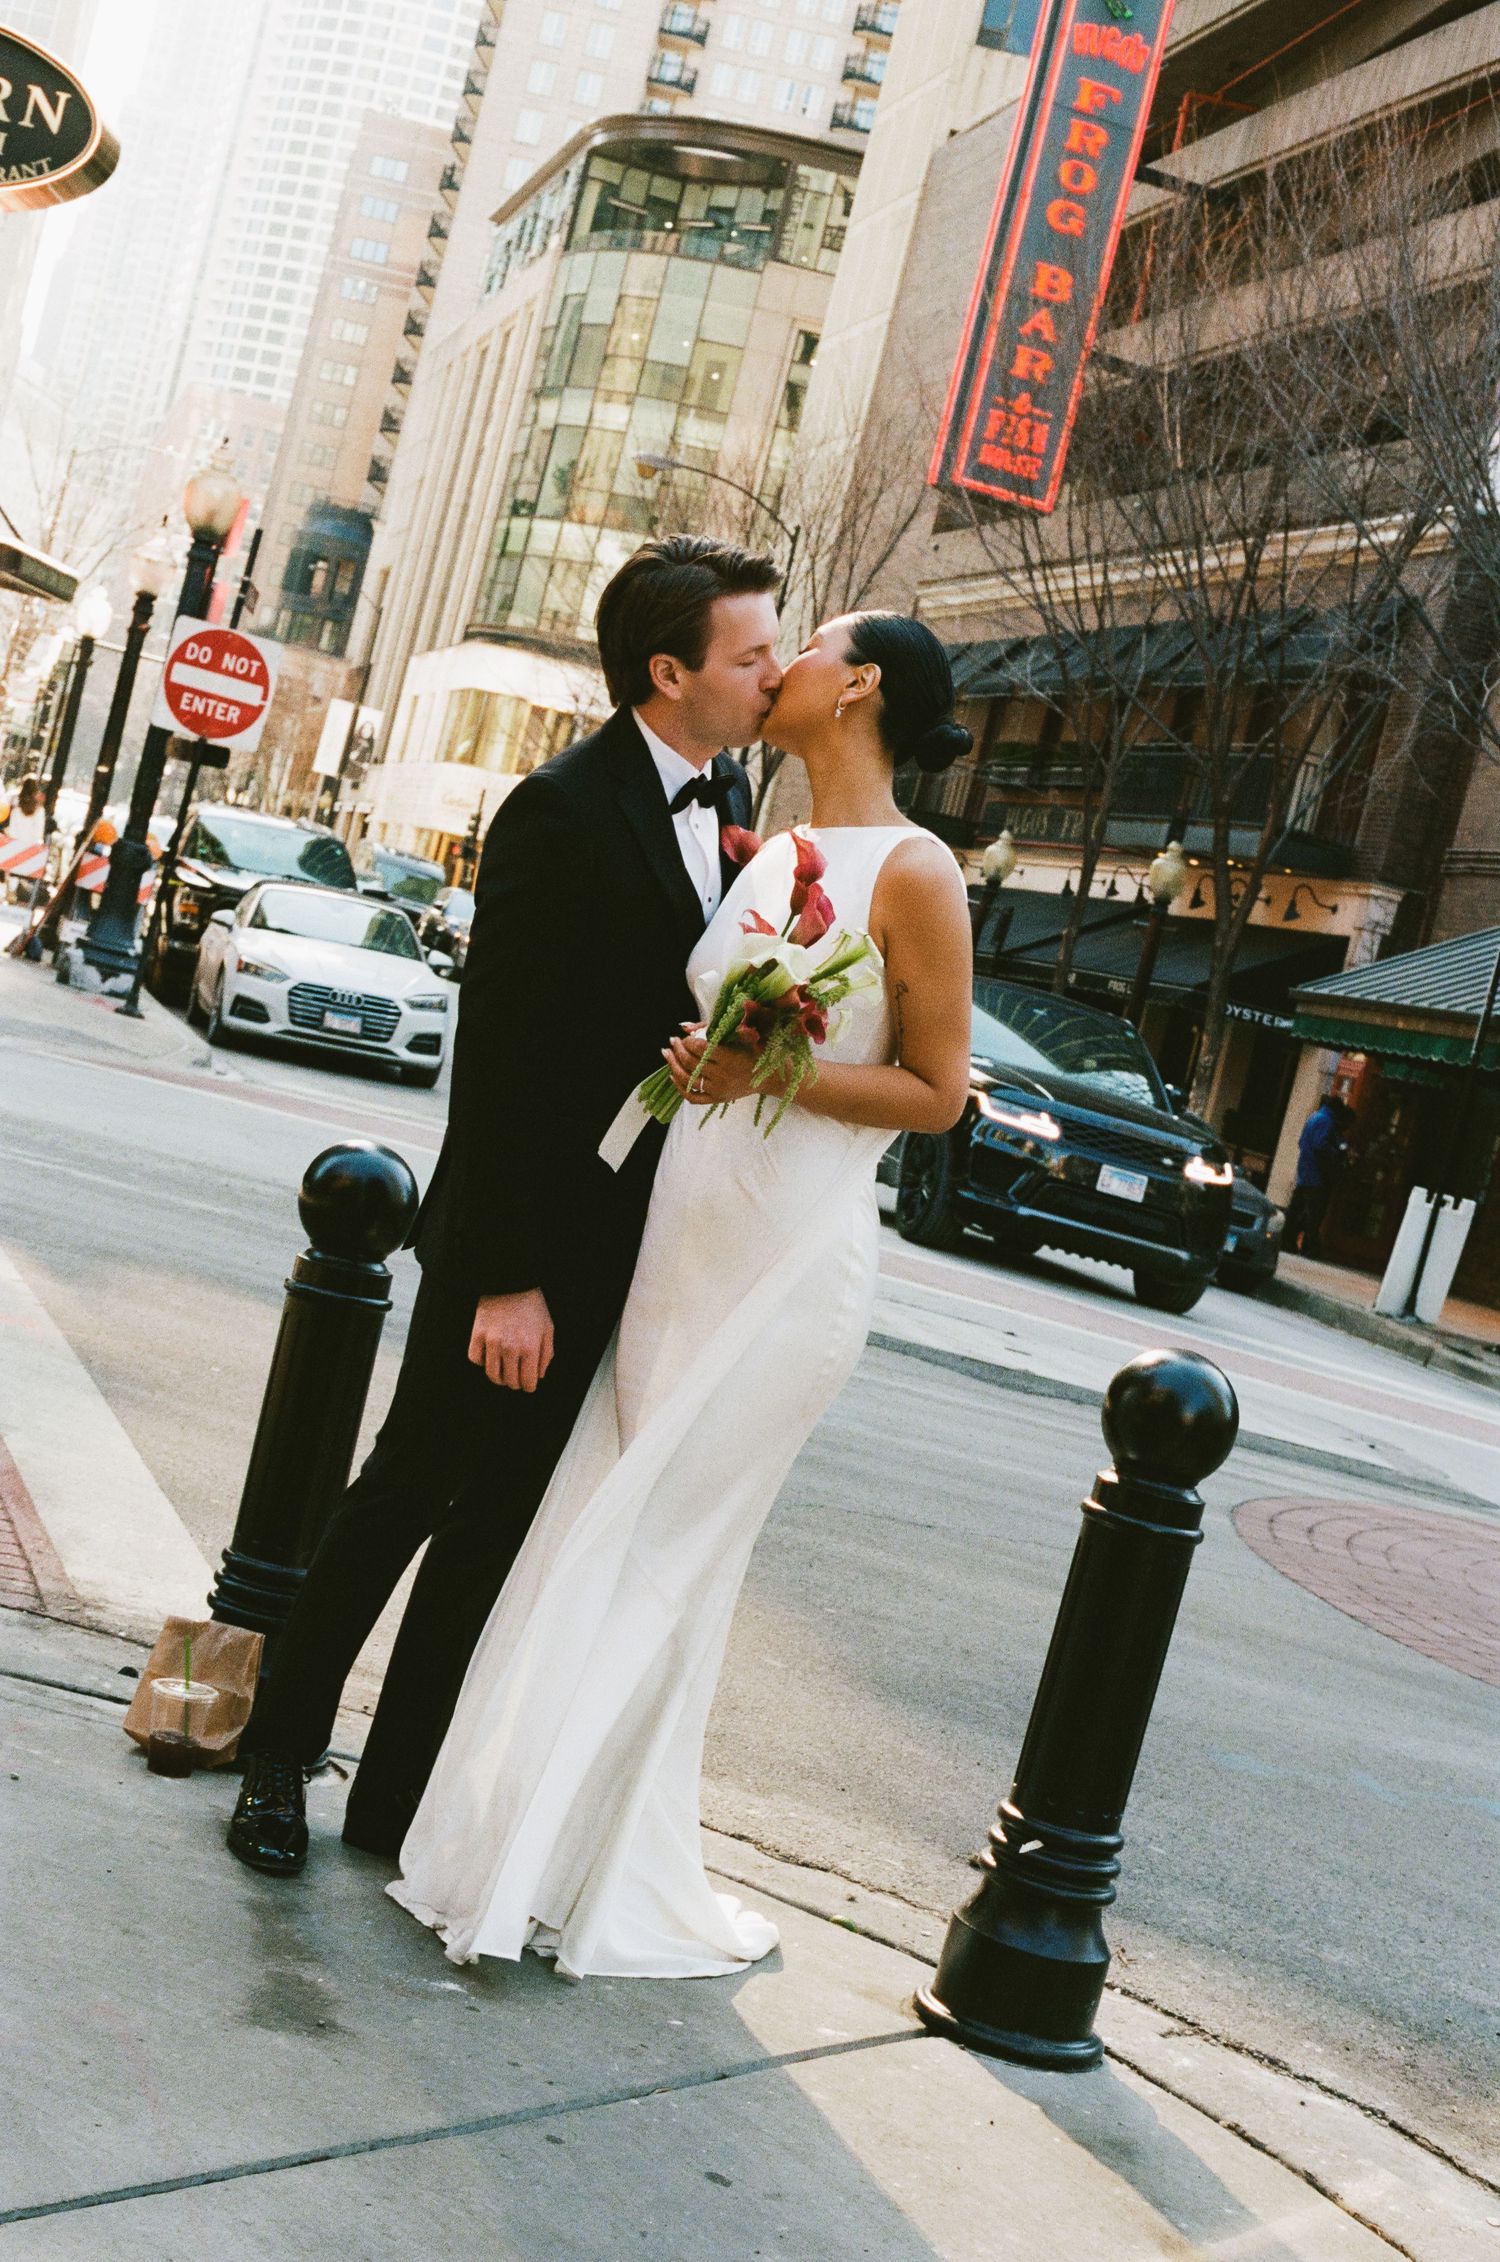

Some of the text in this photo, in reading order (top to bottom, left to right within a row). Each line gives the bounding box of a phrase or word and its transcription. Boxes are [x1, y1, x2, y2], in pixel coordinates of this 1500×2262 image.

[1008, 77, 1122, 385] FROG BAR
[184, 642, 262, 678] DO NOT
[179, 691, 241, 725] ENTER
